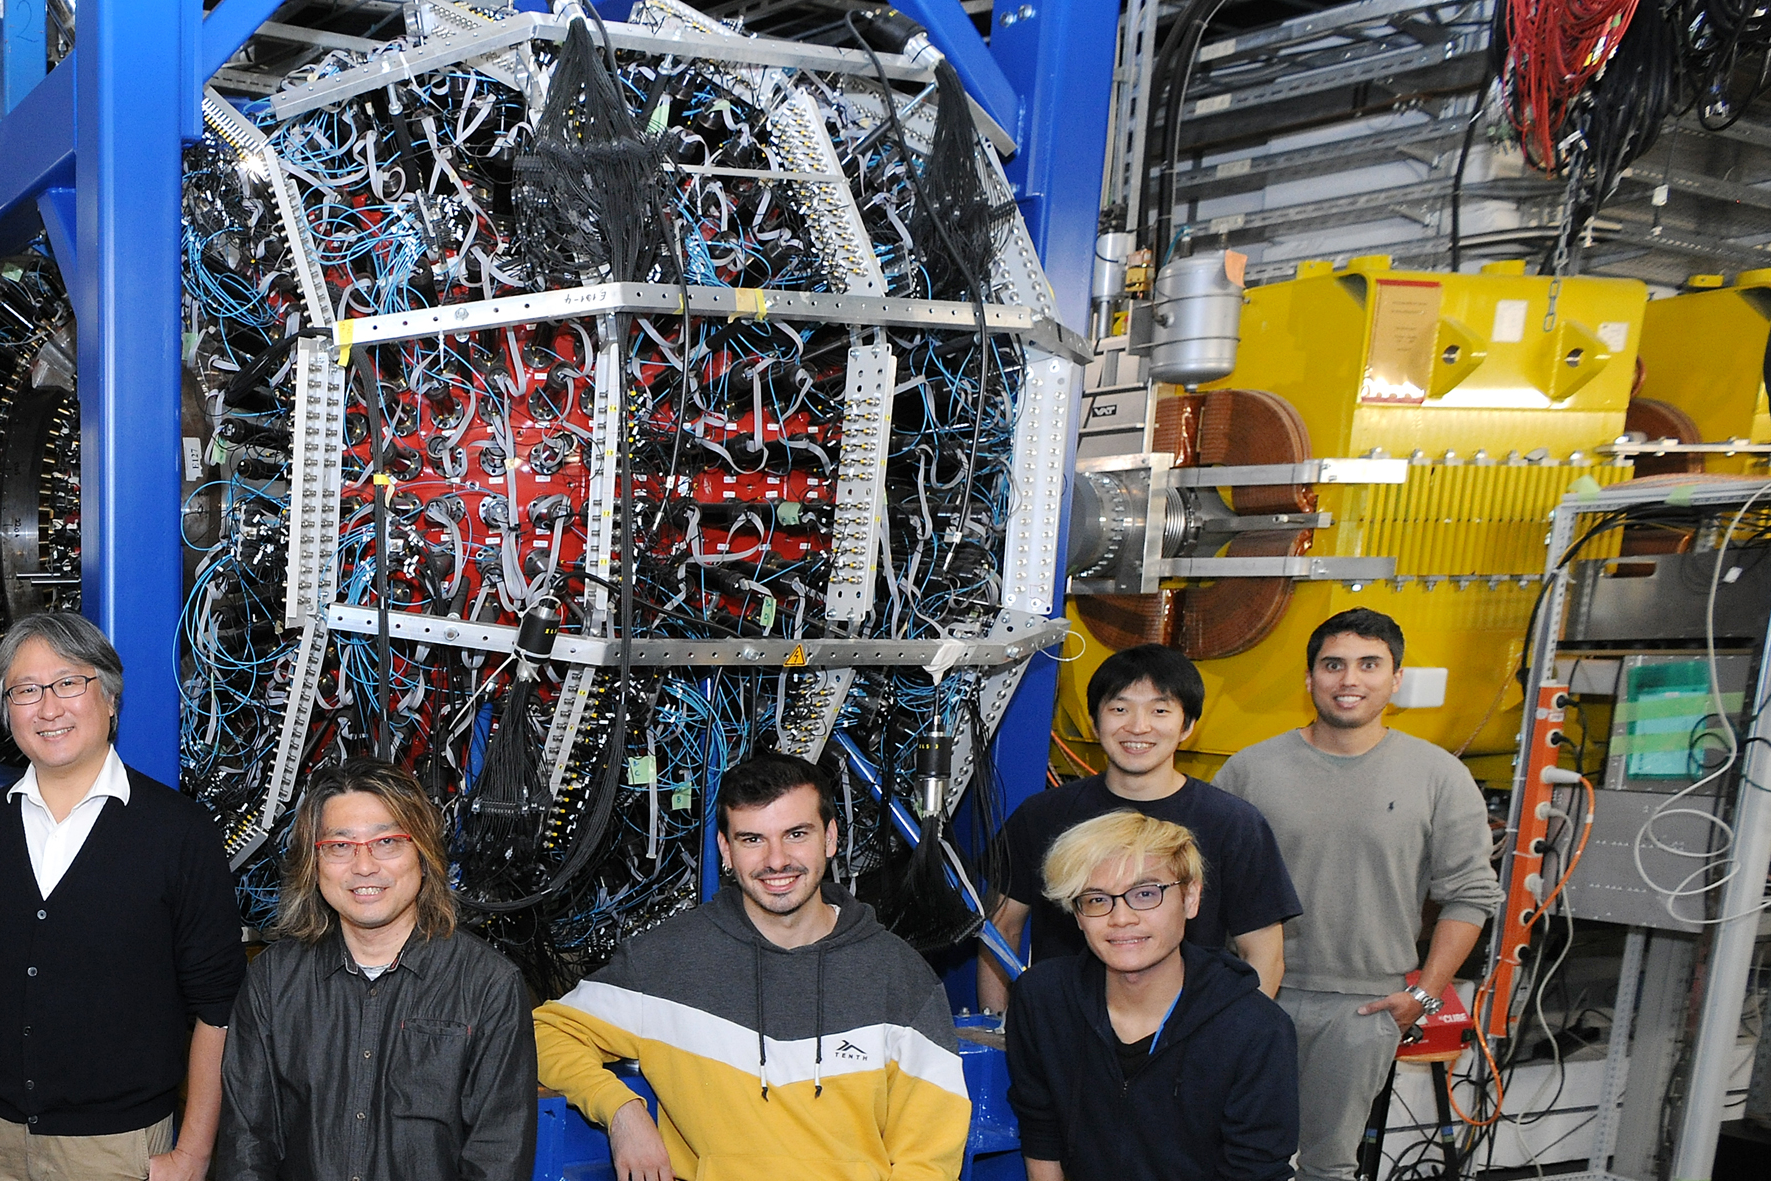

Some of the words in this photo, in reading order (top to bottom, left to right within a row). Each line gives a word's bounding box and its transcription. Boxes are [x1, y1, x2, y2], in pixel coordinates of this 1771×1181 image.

[16, 0, 39, 43] 2
[1094, 406, 1115, 416] VAT
[191, 449, 200, 469] E127
[835, 1052, 868, 1061] TENTH
